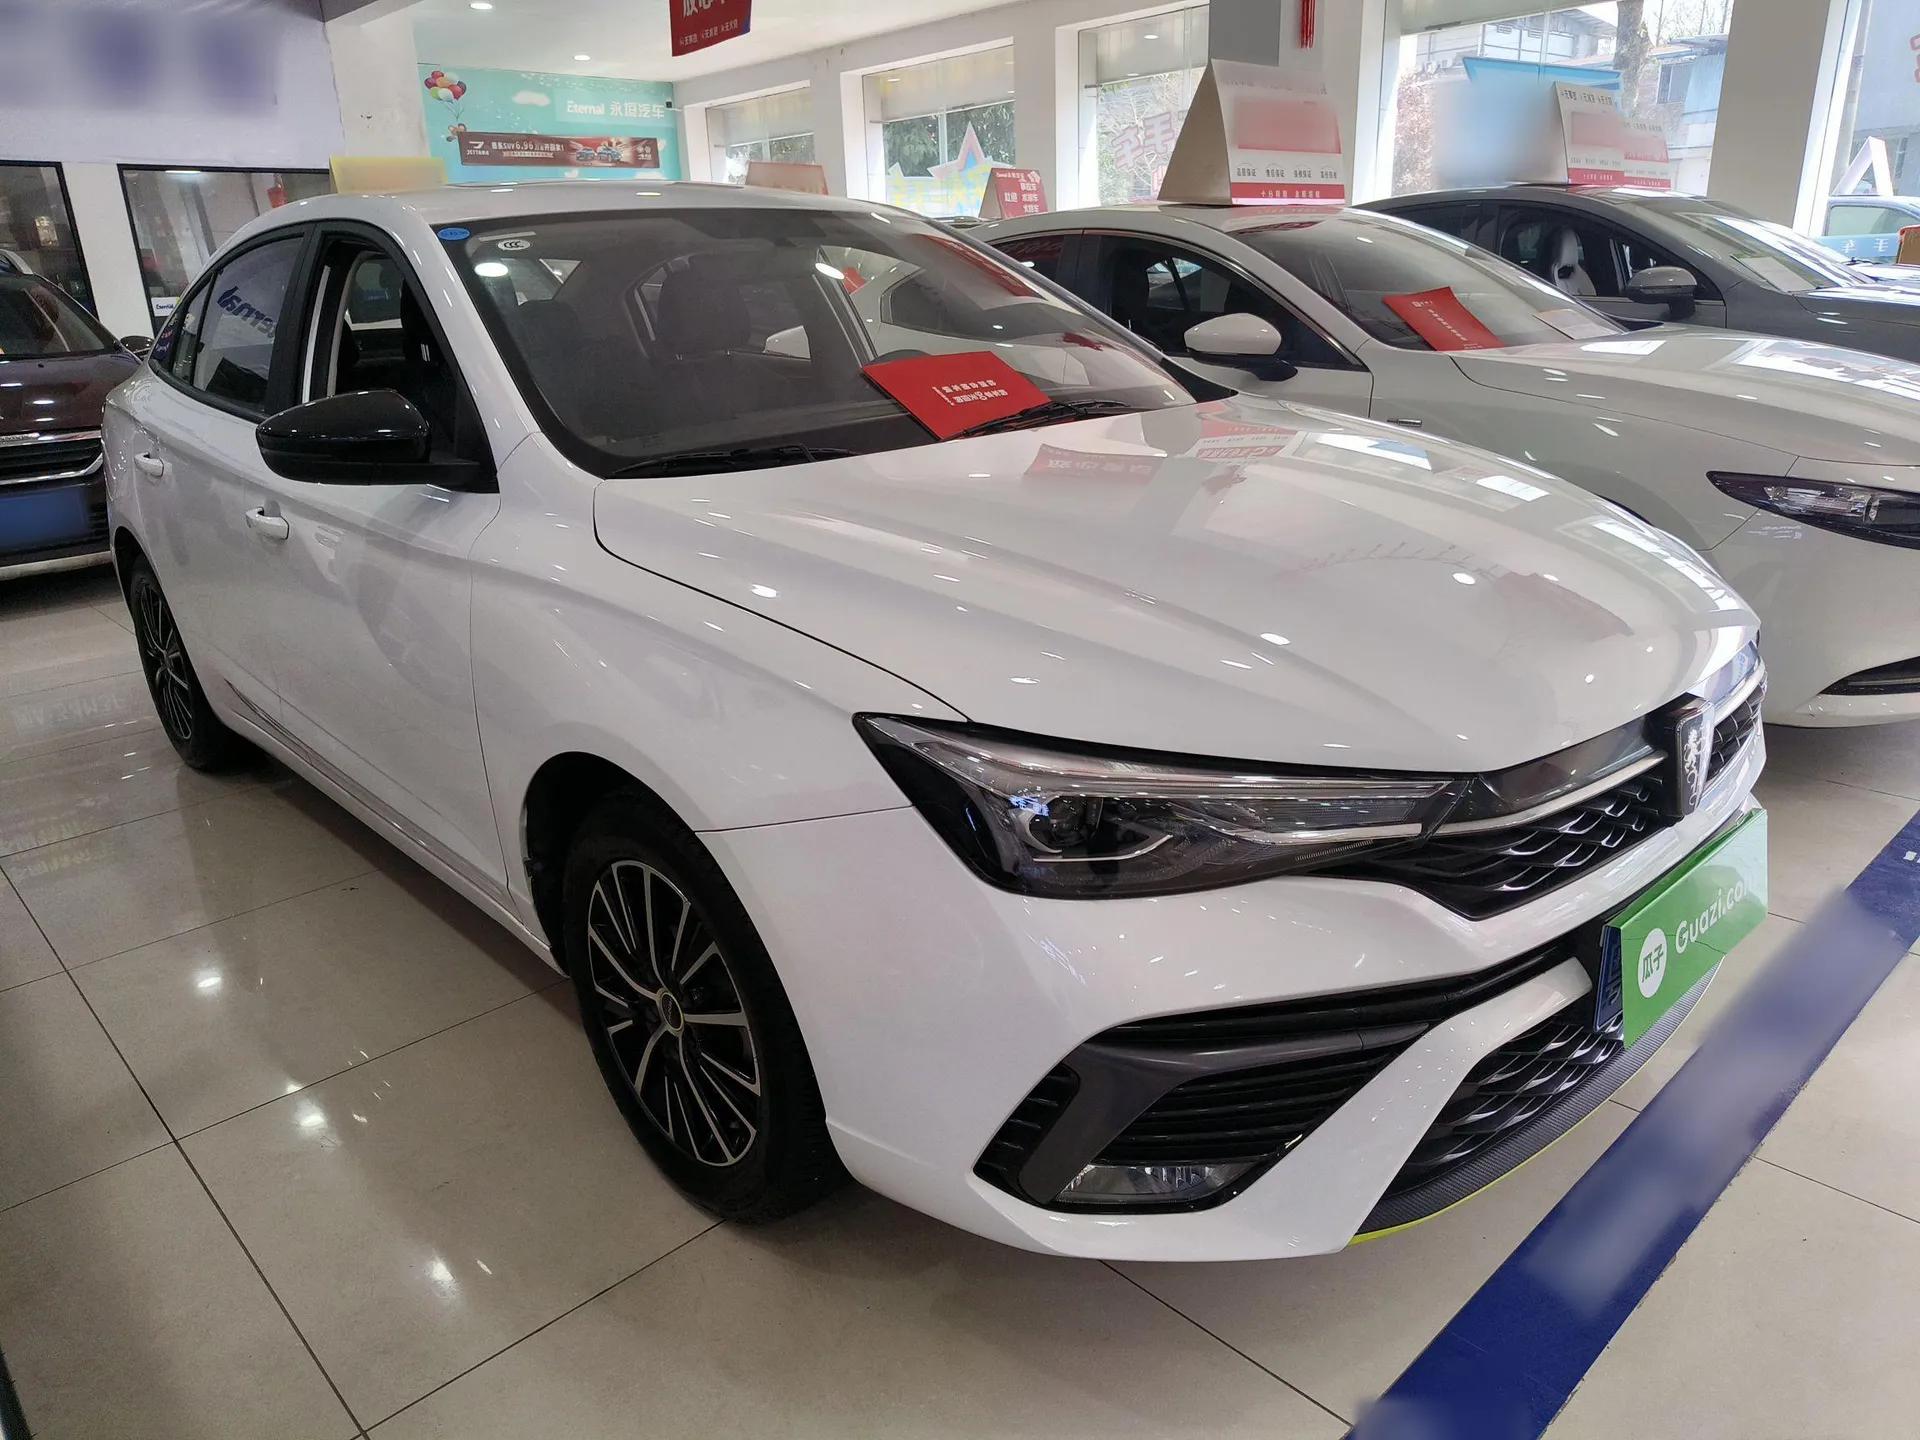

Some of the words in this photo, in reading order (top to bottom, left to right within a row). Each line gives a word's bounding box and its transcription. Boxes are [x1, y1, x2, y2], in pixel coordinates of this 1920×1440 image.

[567, 101, 604, 115] Eternal
[611, 101, 664, 119] 永恒汽车
[1641, 943, 1664, 983] 瓜子
[1675, 875, 1755, 954] Guazi.co
